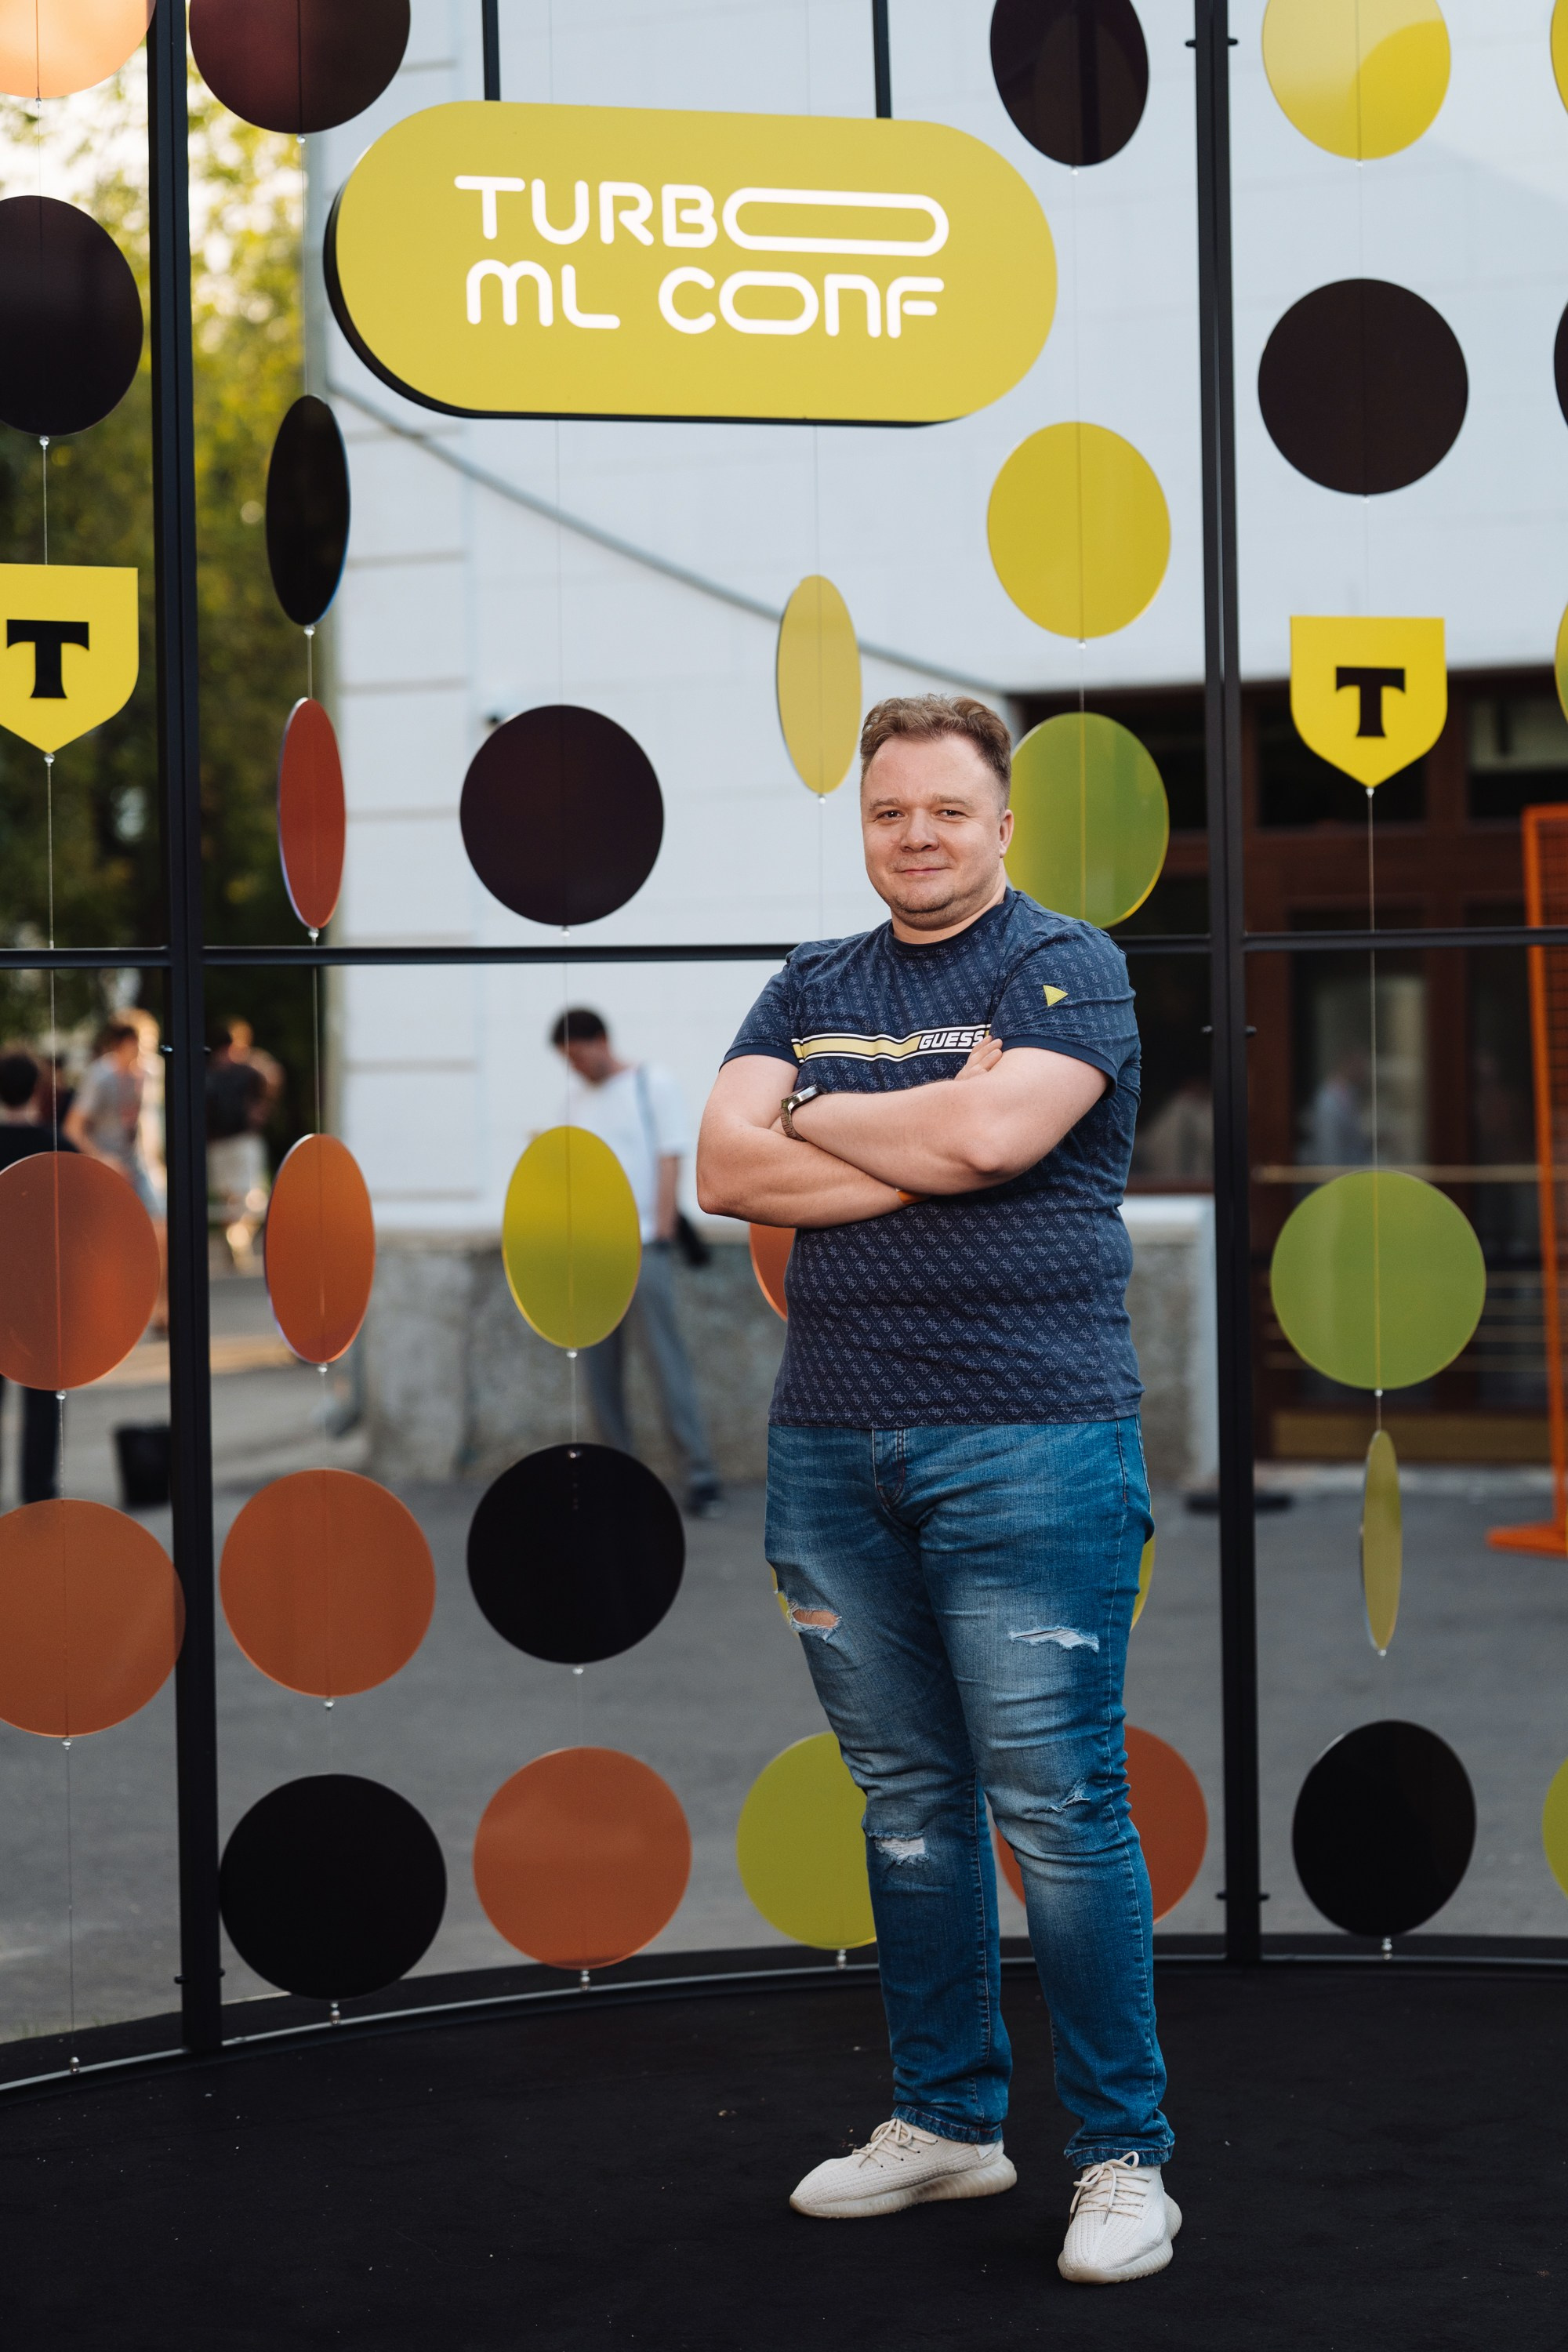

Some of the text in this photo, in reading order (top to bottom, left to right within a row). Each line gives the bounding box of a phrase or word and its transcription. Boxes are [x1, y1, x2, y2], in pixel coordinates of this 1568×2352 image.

[454, 175, 949, 257] TURBO
[658, 266, 945, 339] CONF
[6, 619, 90, 699] T
[1335, 666, 1406, 738] T
[918, 1029, 985, 1050] GUESS
